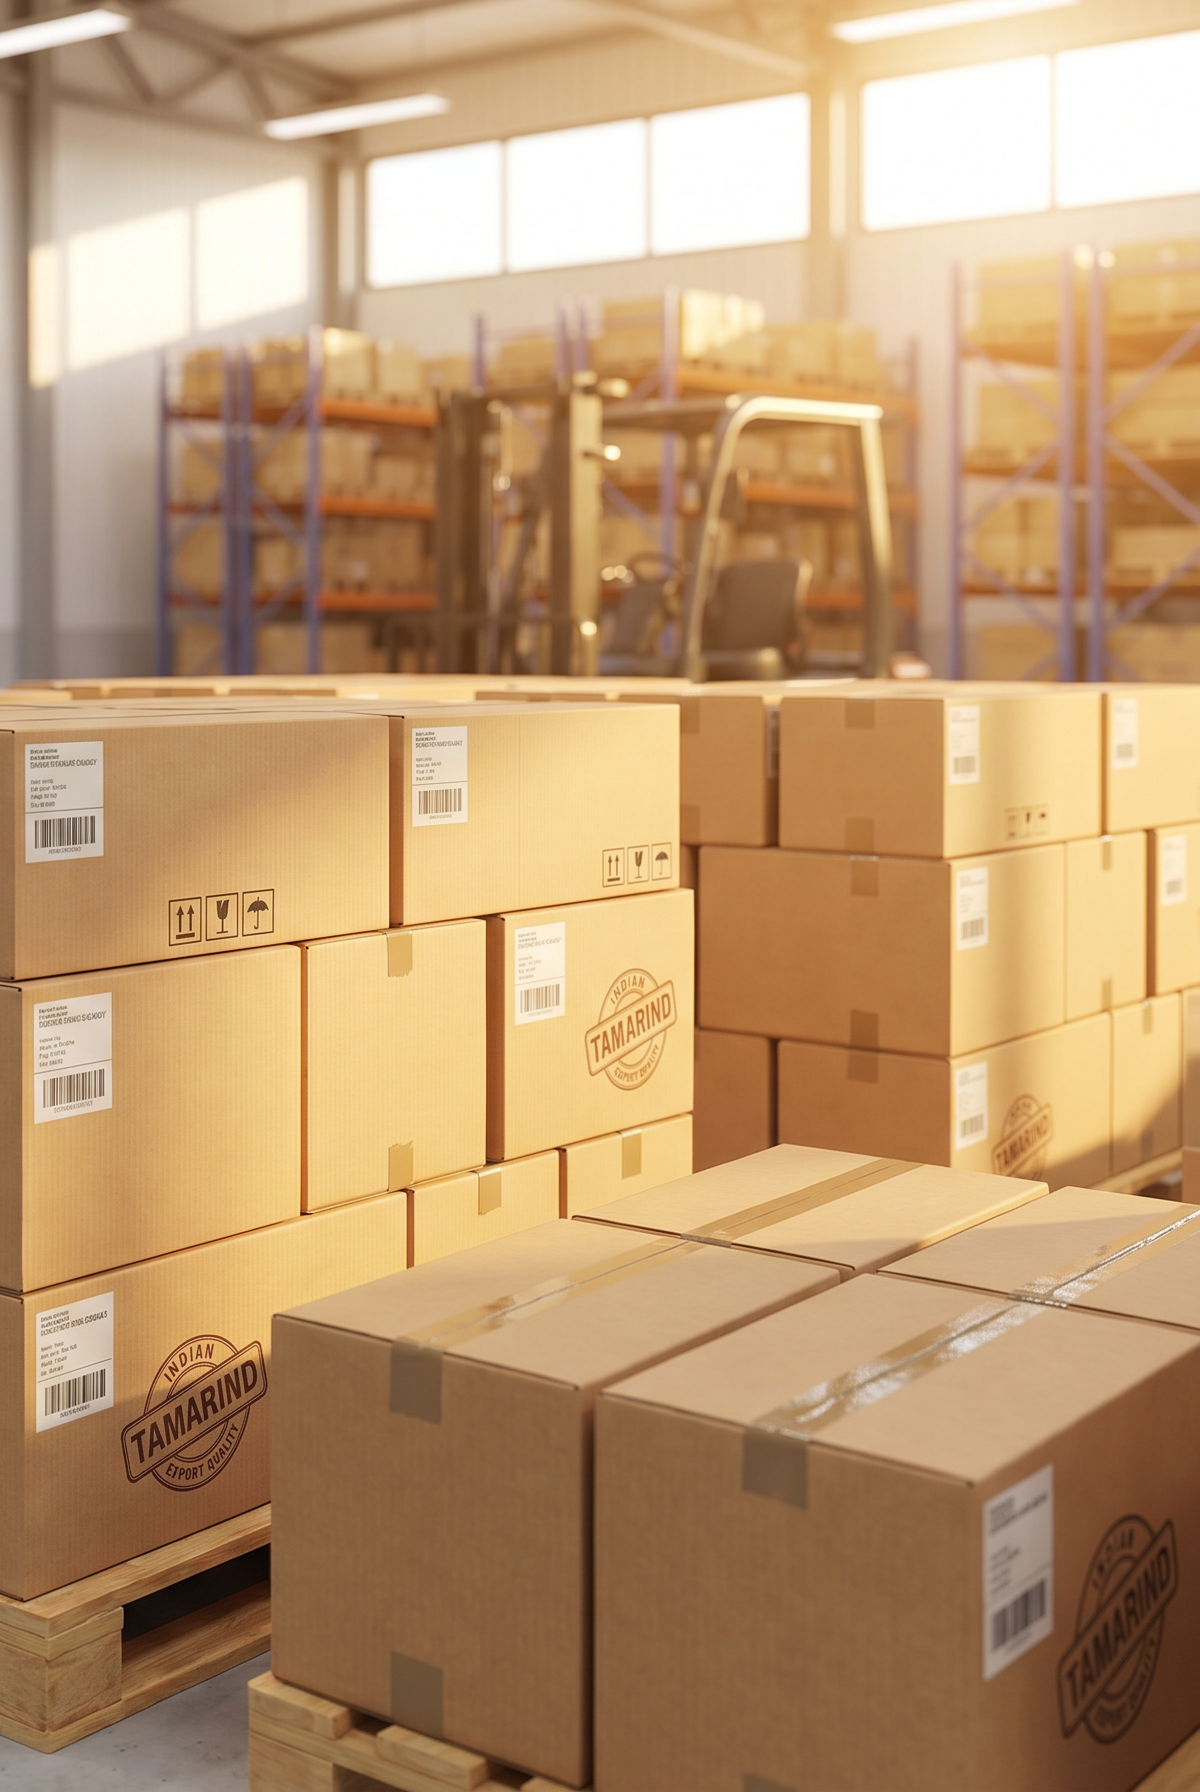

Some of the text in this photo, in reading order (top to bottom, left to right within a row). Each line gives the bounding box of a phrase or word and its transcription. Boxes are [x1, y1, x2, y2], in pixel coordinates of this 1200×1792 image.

[610, 975, 645, 1005] INDIAN
[590, 993, 671, 1063] TAMARIND
[163, 1343, 214, 1383] INDIAN
[130, 1359, 258, 1464] TAMARIND
[208, 1424, 239, 1471] QUALITY
[1066, 1546, 1171, 1708] TAMARIND
